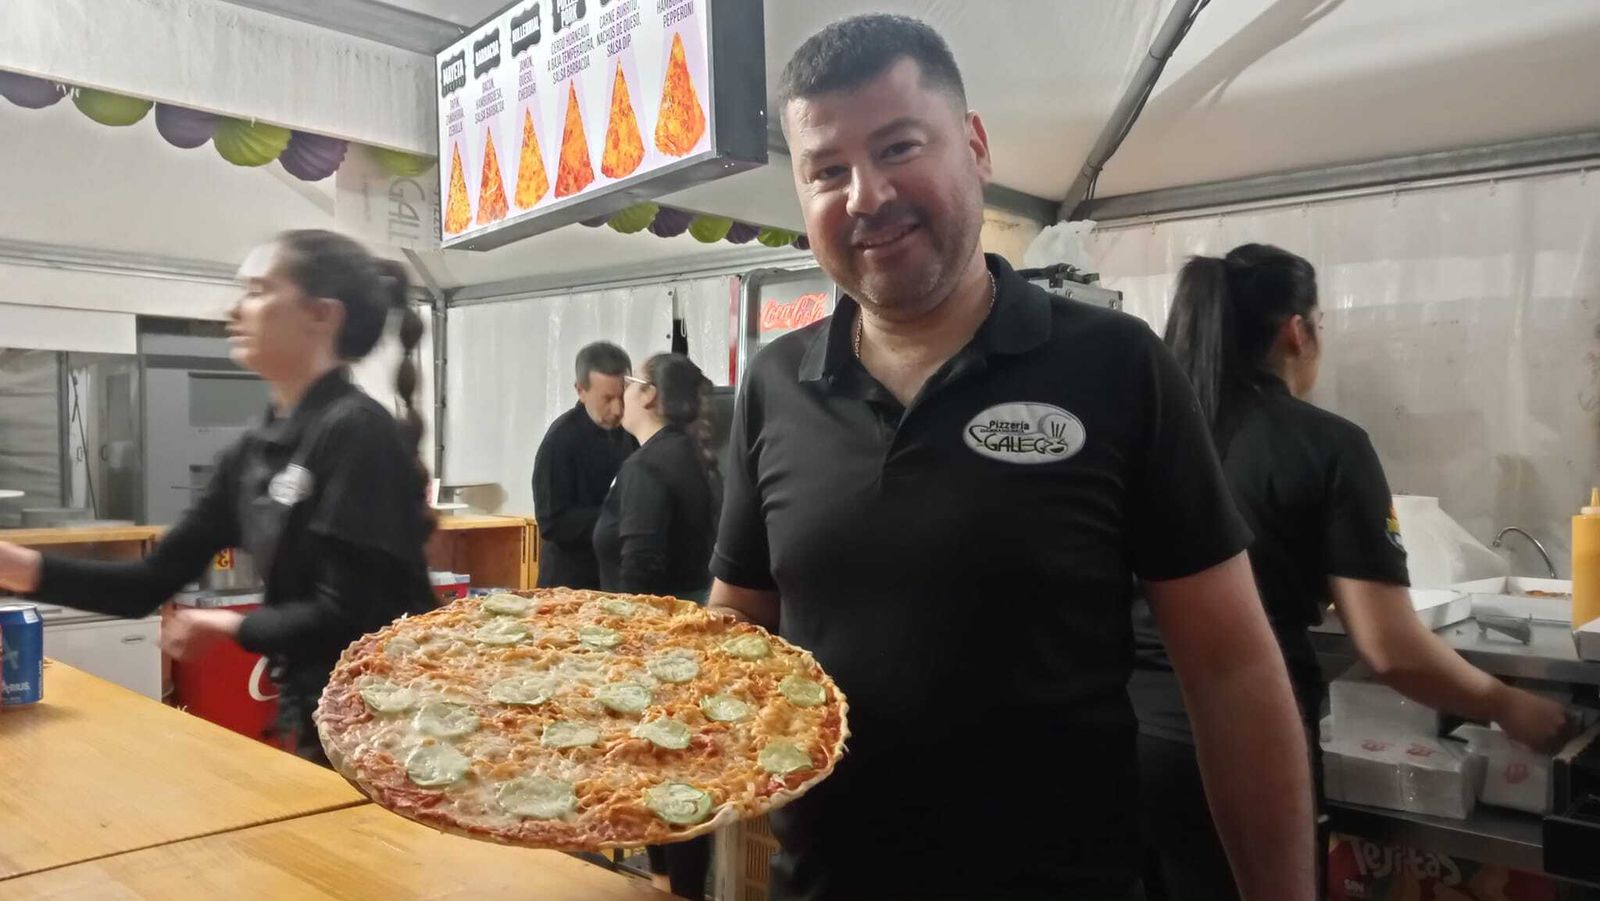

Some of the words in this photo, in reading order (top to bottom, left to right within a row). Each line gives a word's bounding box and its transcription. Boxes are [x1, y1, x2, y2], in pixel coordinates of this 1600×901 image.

[600, 9, 615, 29] CARNE
[663, 1, 694, 28] PEPPERONI
[597, 25, 615, 46] NACHOS
[616, 21, 623, 36] DE
[607, 36, 622, 57] SALSA
[623, 33, 632, 49] DIP
